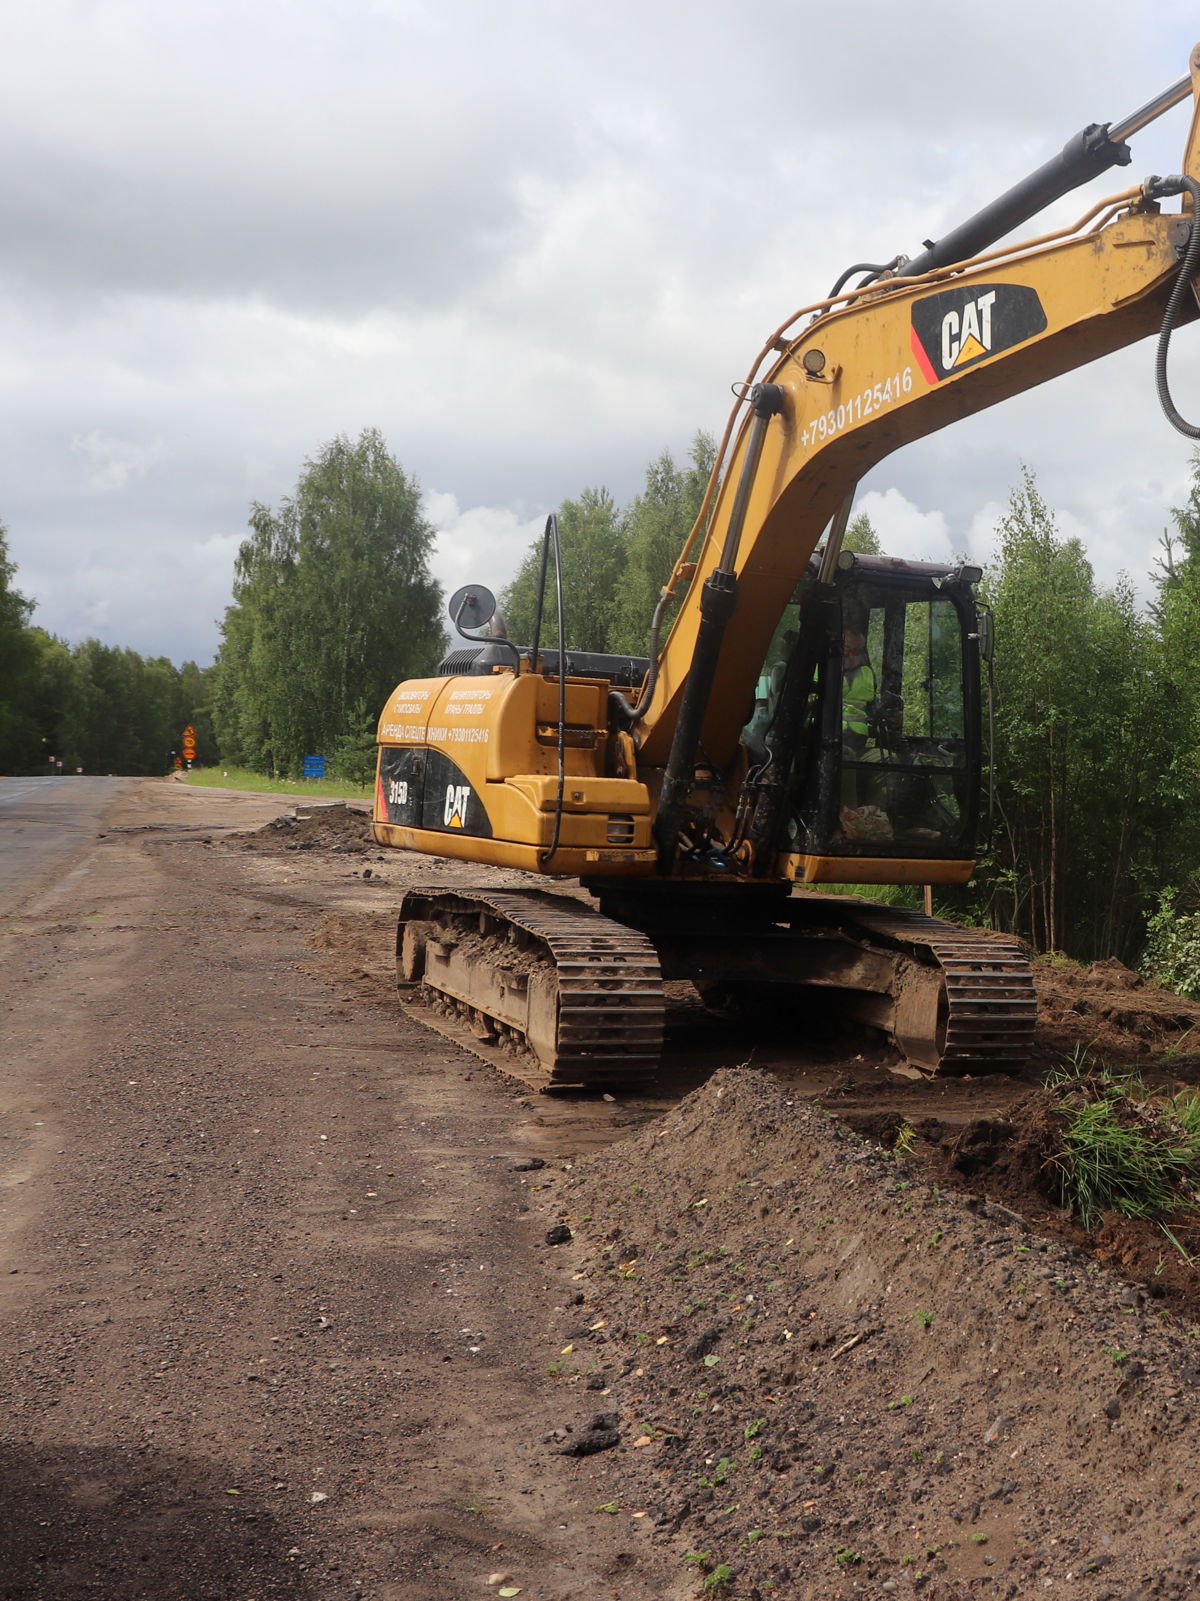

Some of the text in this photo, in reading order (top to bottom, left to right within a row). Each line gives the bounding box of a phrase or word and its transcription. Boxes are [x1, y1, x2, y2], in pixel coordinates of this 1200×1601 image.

[941, 290, 996, 371] CAT
[801, 366, 913, 447] +79301125416
[381, 724, 405, 739] АРЕНДА
[443, 784, 471, 829] CAT
